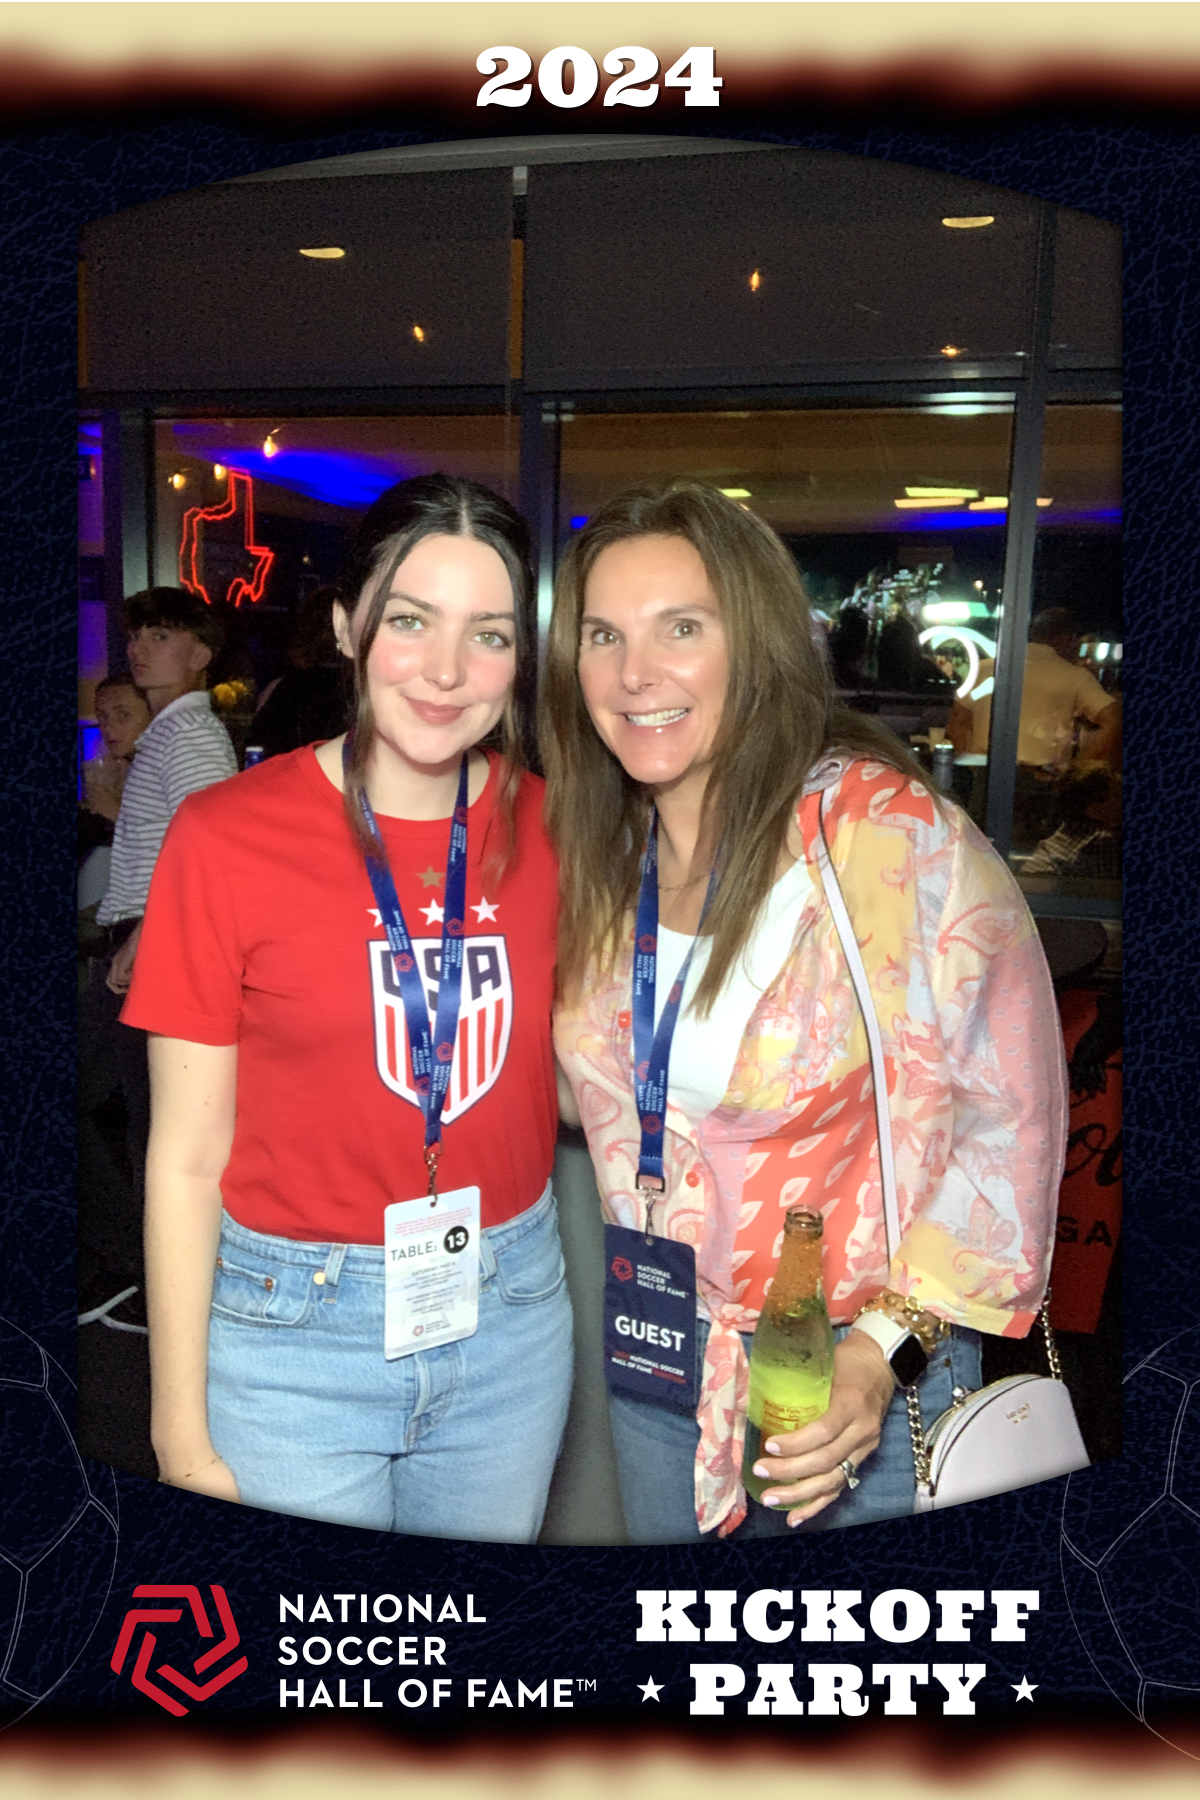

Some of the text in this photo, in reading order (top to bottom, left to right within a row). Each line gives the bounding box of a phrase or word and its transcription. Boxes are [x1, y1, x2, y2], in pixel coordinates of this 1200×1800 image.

[444, 954, 450, 963] OF
[636, 970, 642, 978] OF
[645, 1080, 653, 1110] NATIONAL
[657, 1087, 664, 1096] OF
[389, 1231, 467, 1262] TABLE: 13
[637, 1264, 671, 1279] NATIONAL
[637, 1271, 666, 1285] SOCCER
[637, 1279, 655, 1290] HALL
[656, 1284, 666, 1292] OF
[615, 1315, 686, 1351] GUEST
[611, 1356, 653, 1374] HALL OF FAME
[629, 1355, 659, 1369] NATIONAL
[660, 1363, 685, 1376] SOCCER
